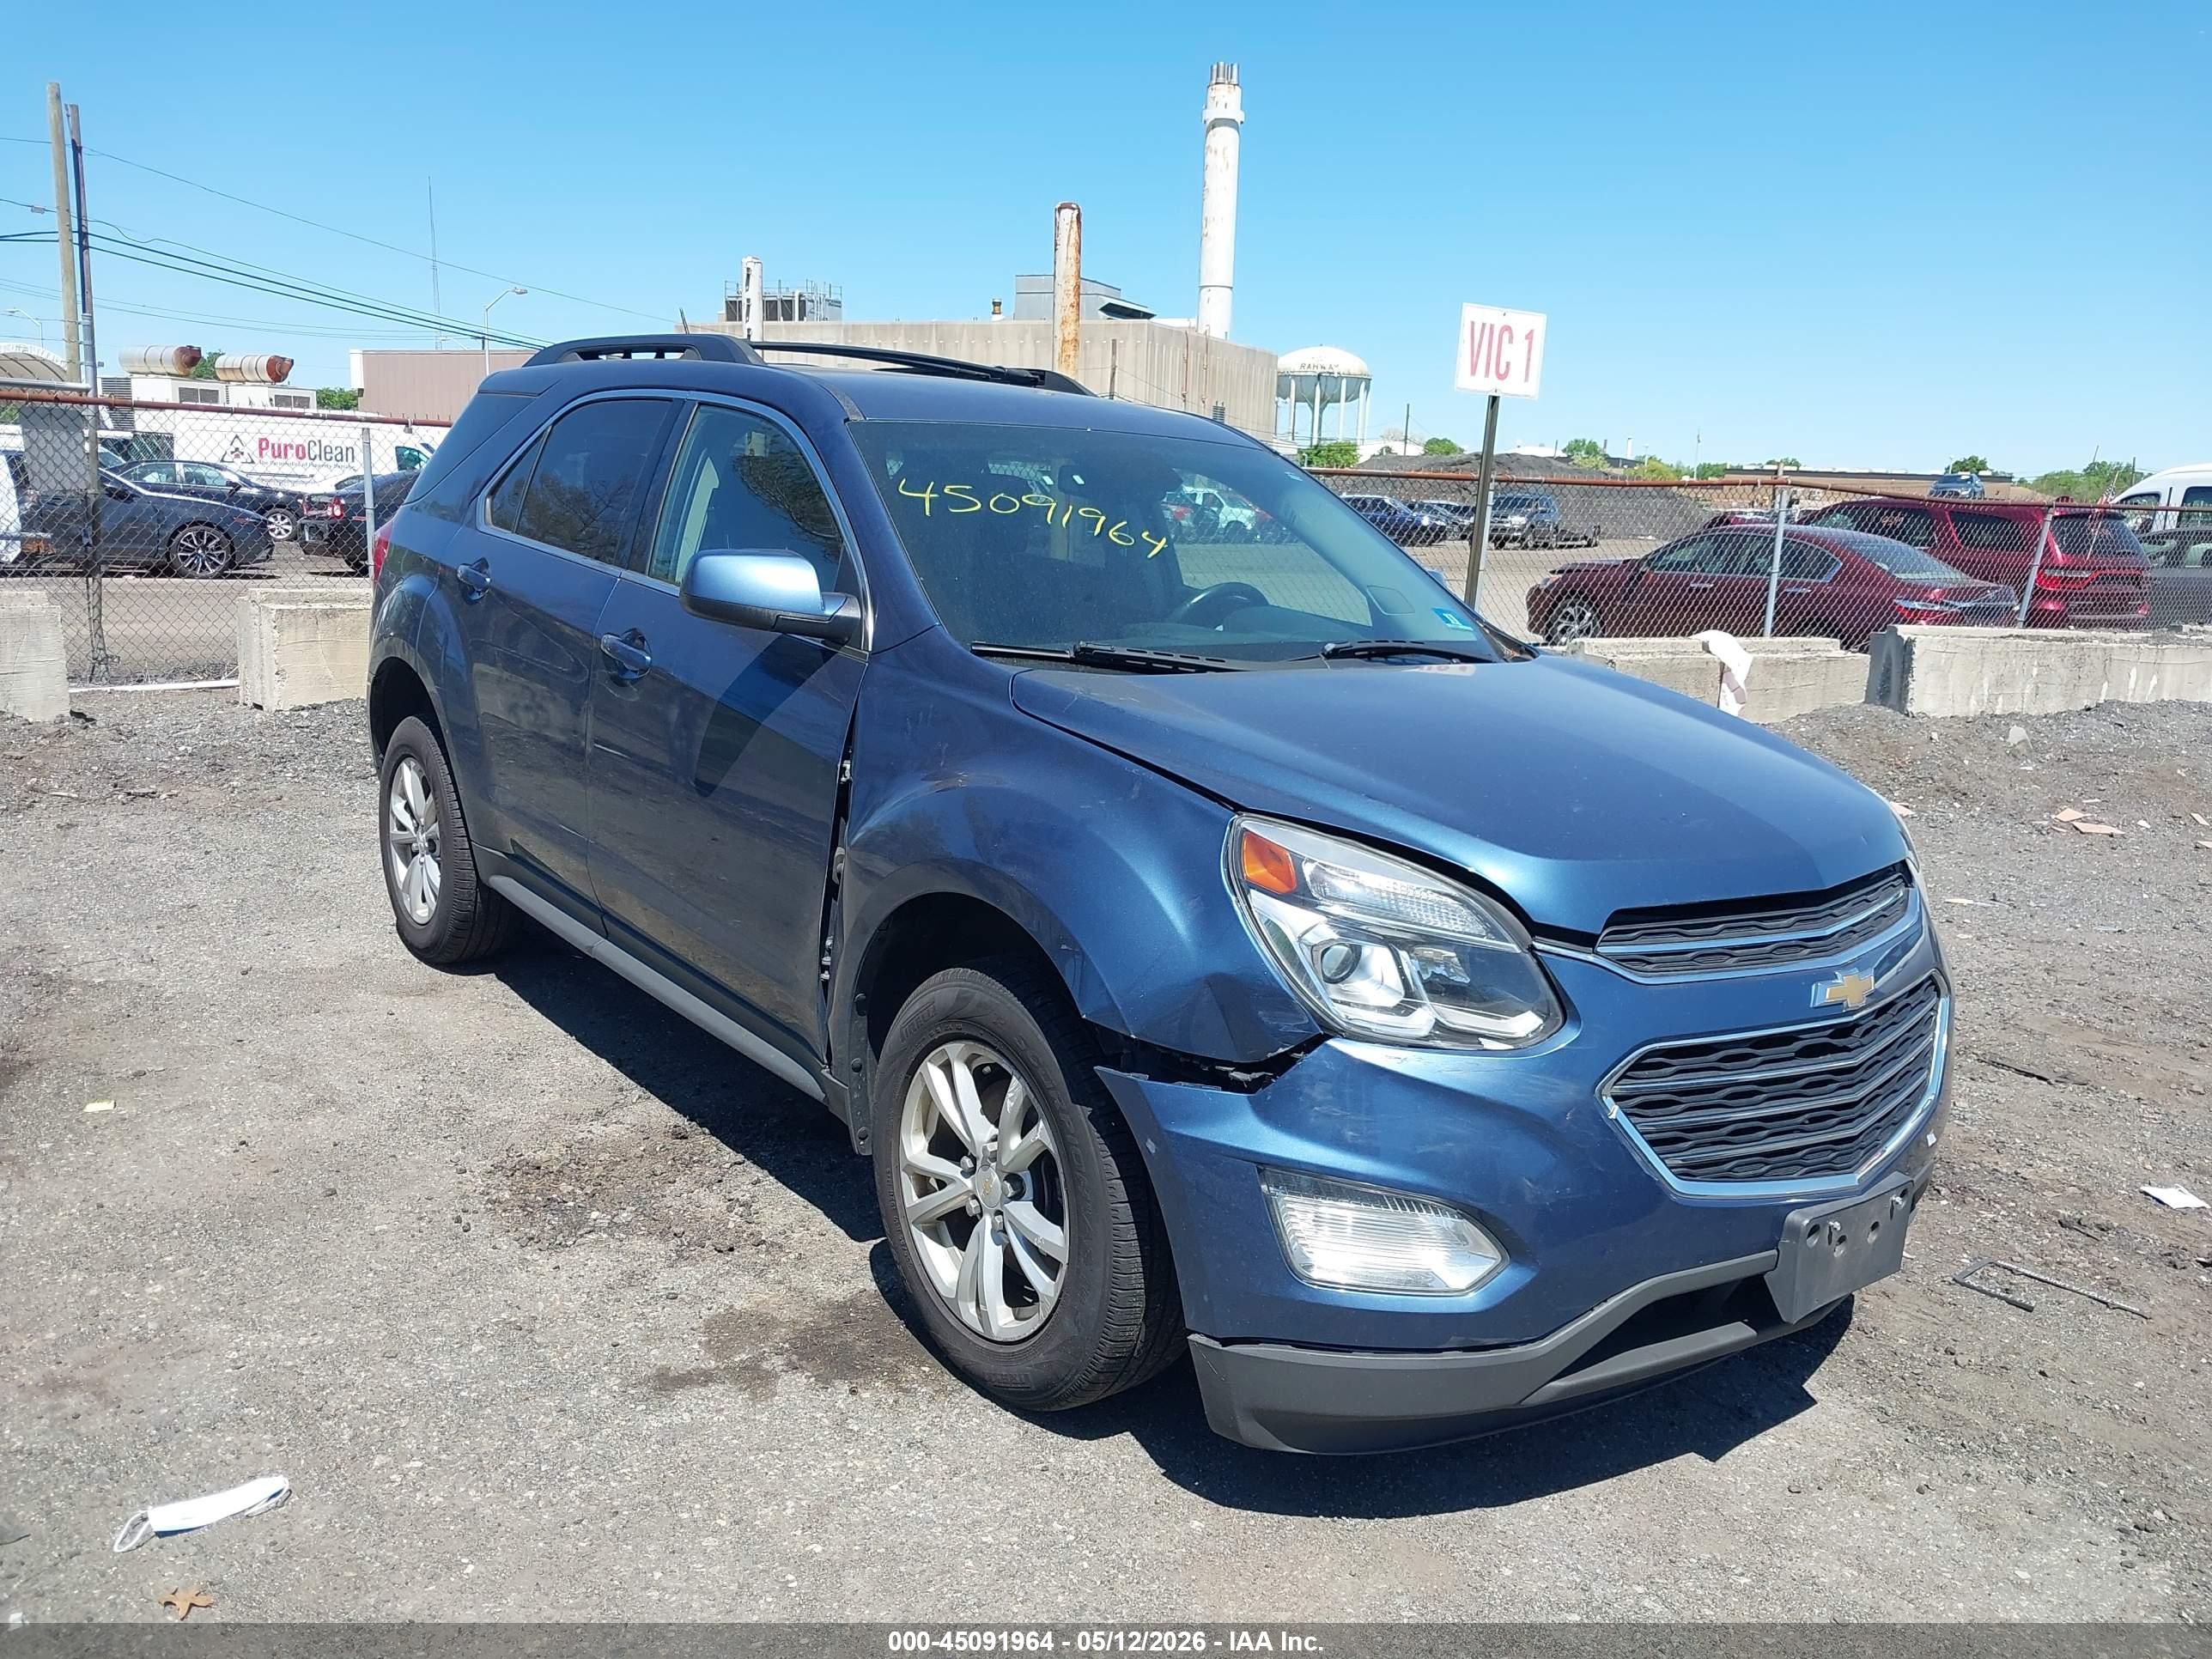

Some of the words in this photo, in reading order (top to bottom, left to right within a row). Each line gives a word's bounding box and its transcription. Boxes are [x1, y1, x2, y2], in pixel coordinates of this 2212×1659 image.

[1470, 320, 1514, 380] VIC
[1524, 329, 1534, 382] 1
[258, 437, 356, 463] PuroClean
[898, 477, 1168, 559] 45091964
